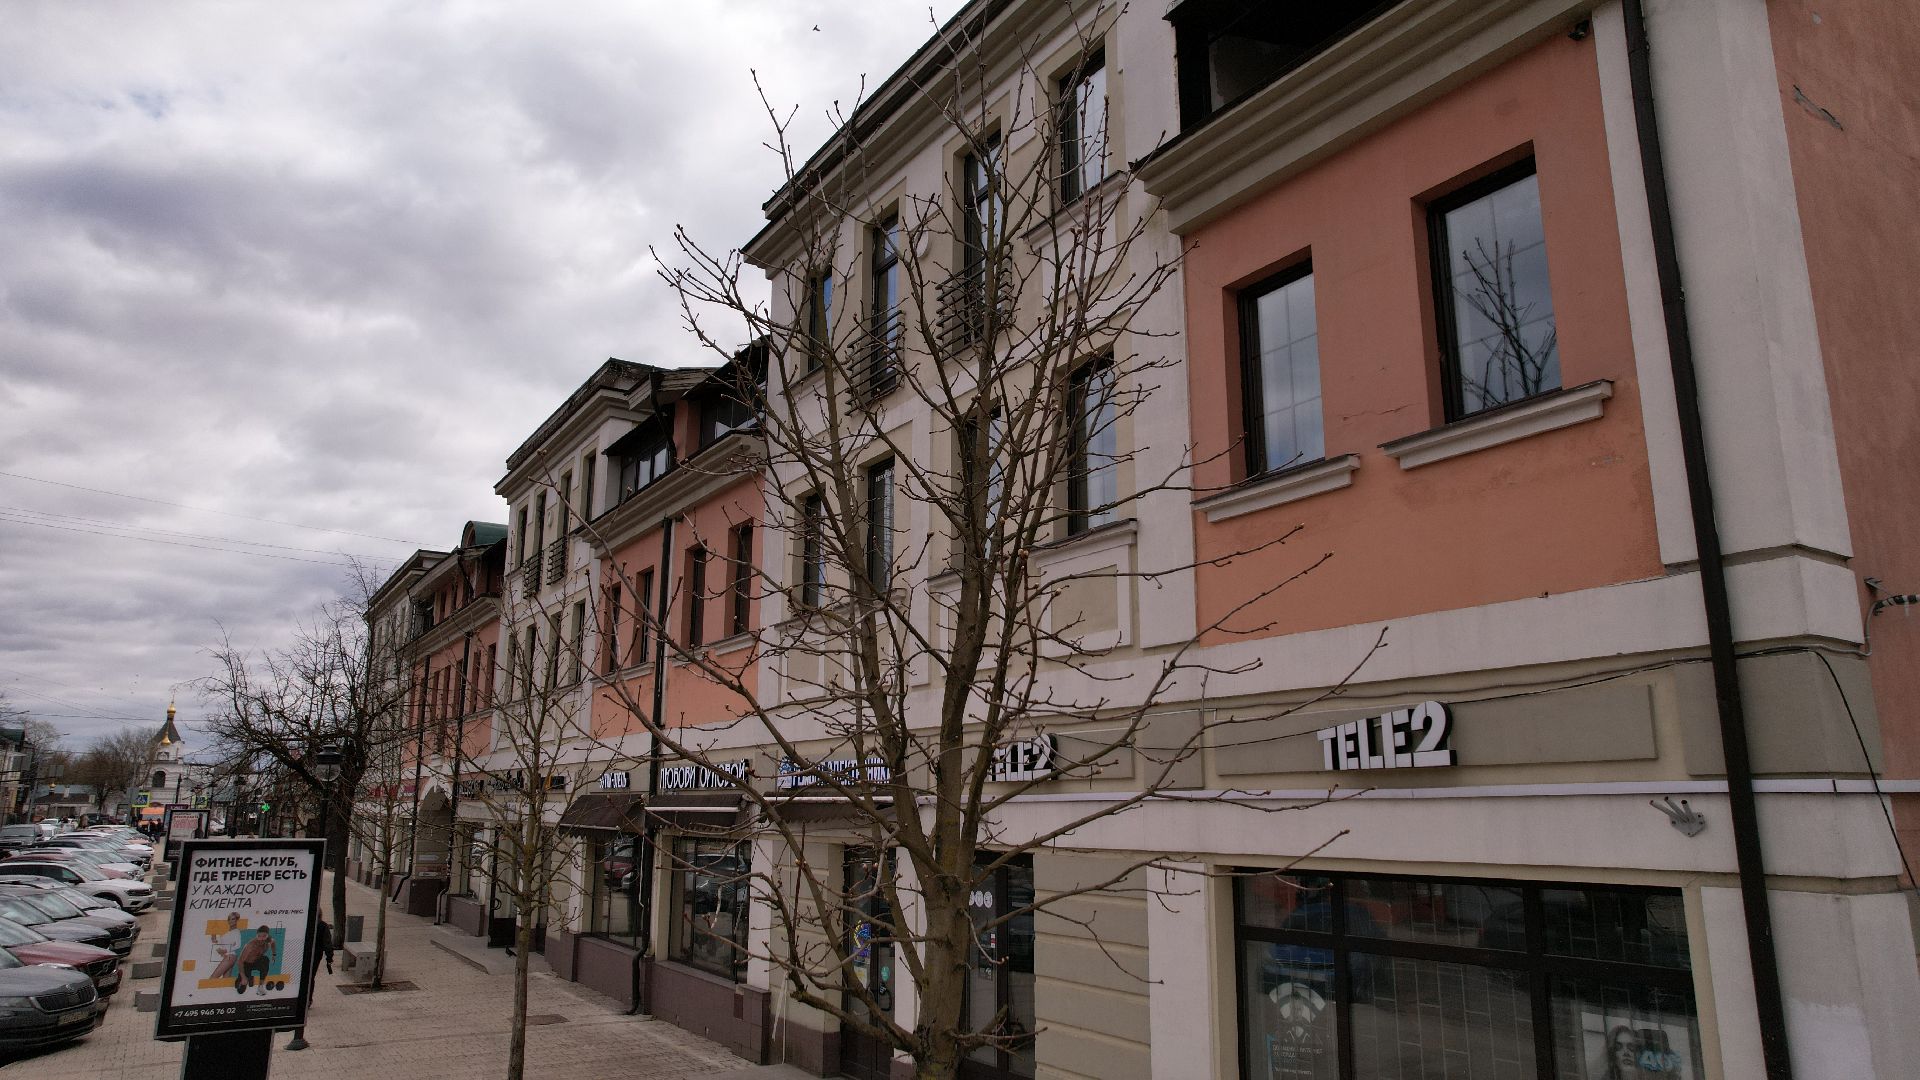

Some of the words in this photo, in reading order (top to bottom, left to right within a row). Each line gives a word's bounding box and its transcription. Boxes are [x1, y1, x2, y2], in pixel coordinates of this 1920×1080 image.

[1317, 700, 1451, 770] TELE2
[988, 733, 1052, 782] ELE2
[660, 765, 696, 789] ЛЮБОВИ
[700, 758, 746, 788] ОРЛОВОЙ
[195, 856, 298, 868] ФИТНЕС-КЛУБ,
[193, 870, 218, 883] ГДЕ
[221, 870, 272, 881] ТРЕНЕР
[274, 869, 307, 880] ЕСТЬ
[191, 884, 200, 896] У
[204, 883, 275, 896] КАЖДОГО
[189, 897, 252, 910] КЛИЕНТА
[184, 1009, 198, 1017] 495
[201, 1007, 214, 1016] 946
[226, 1006, 236, 1014] 02
